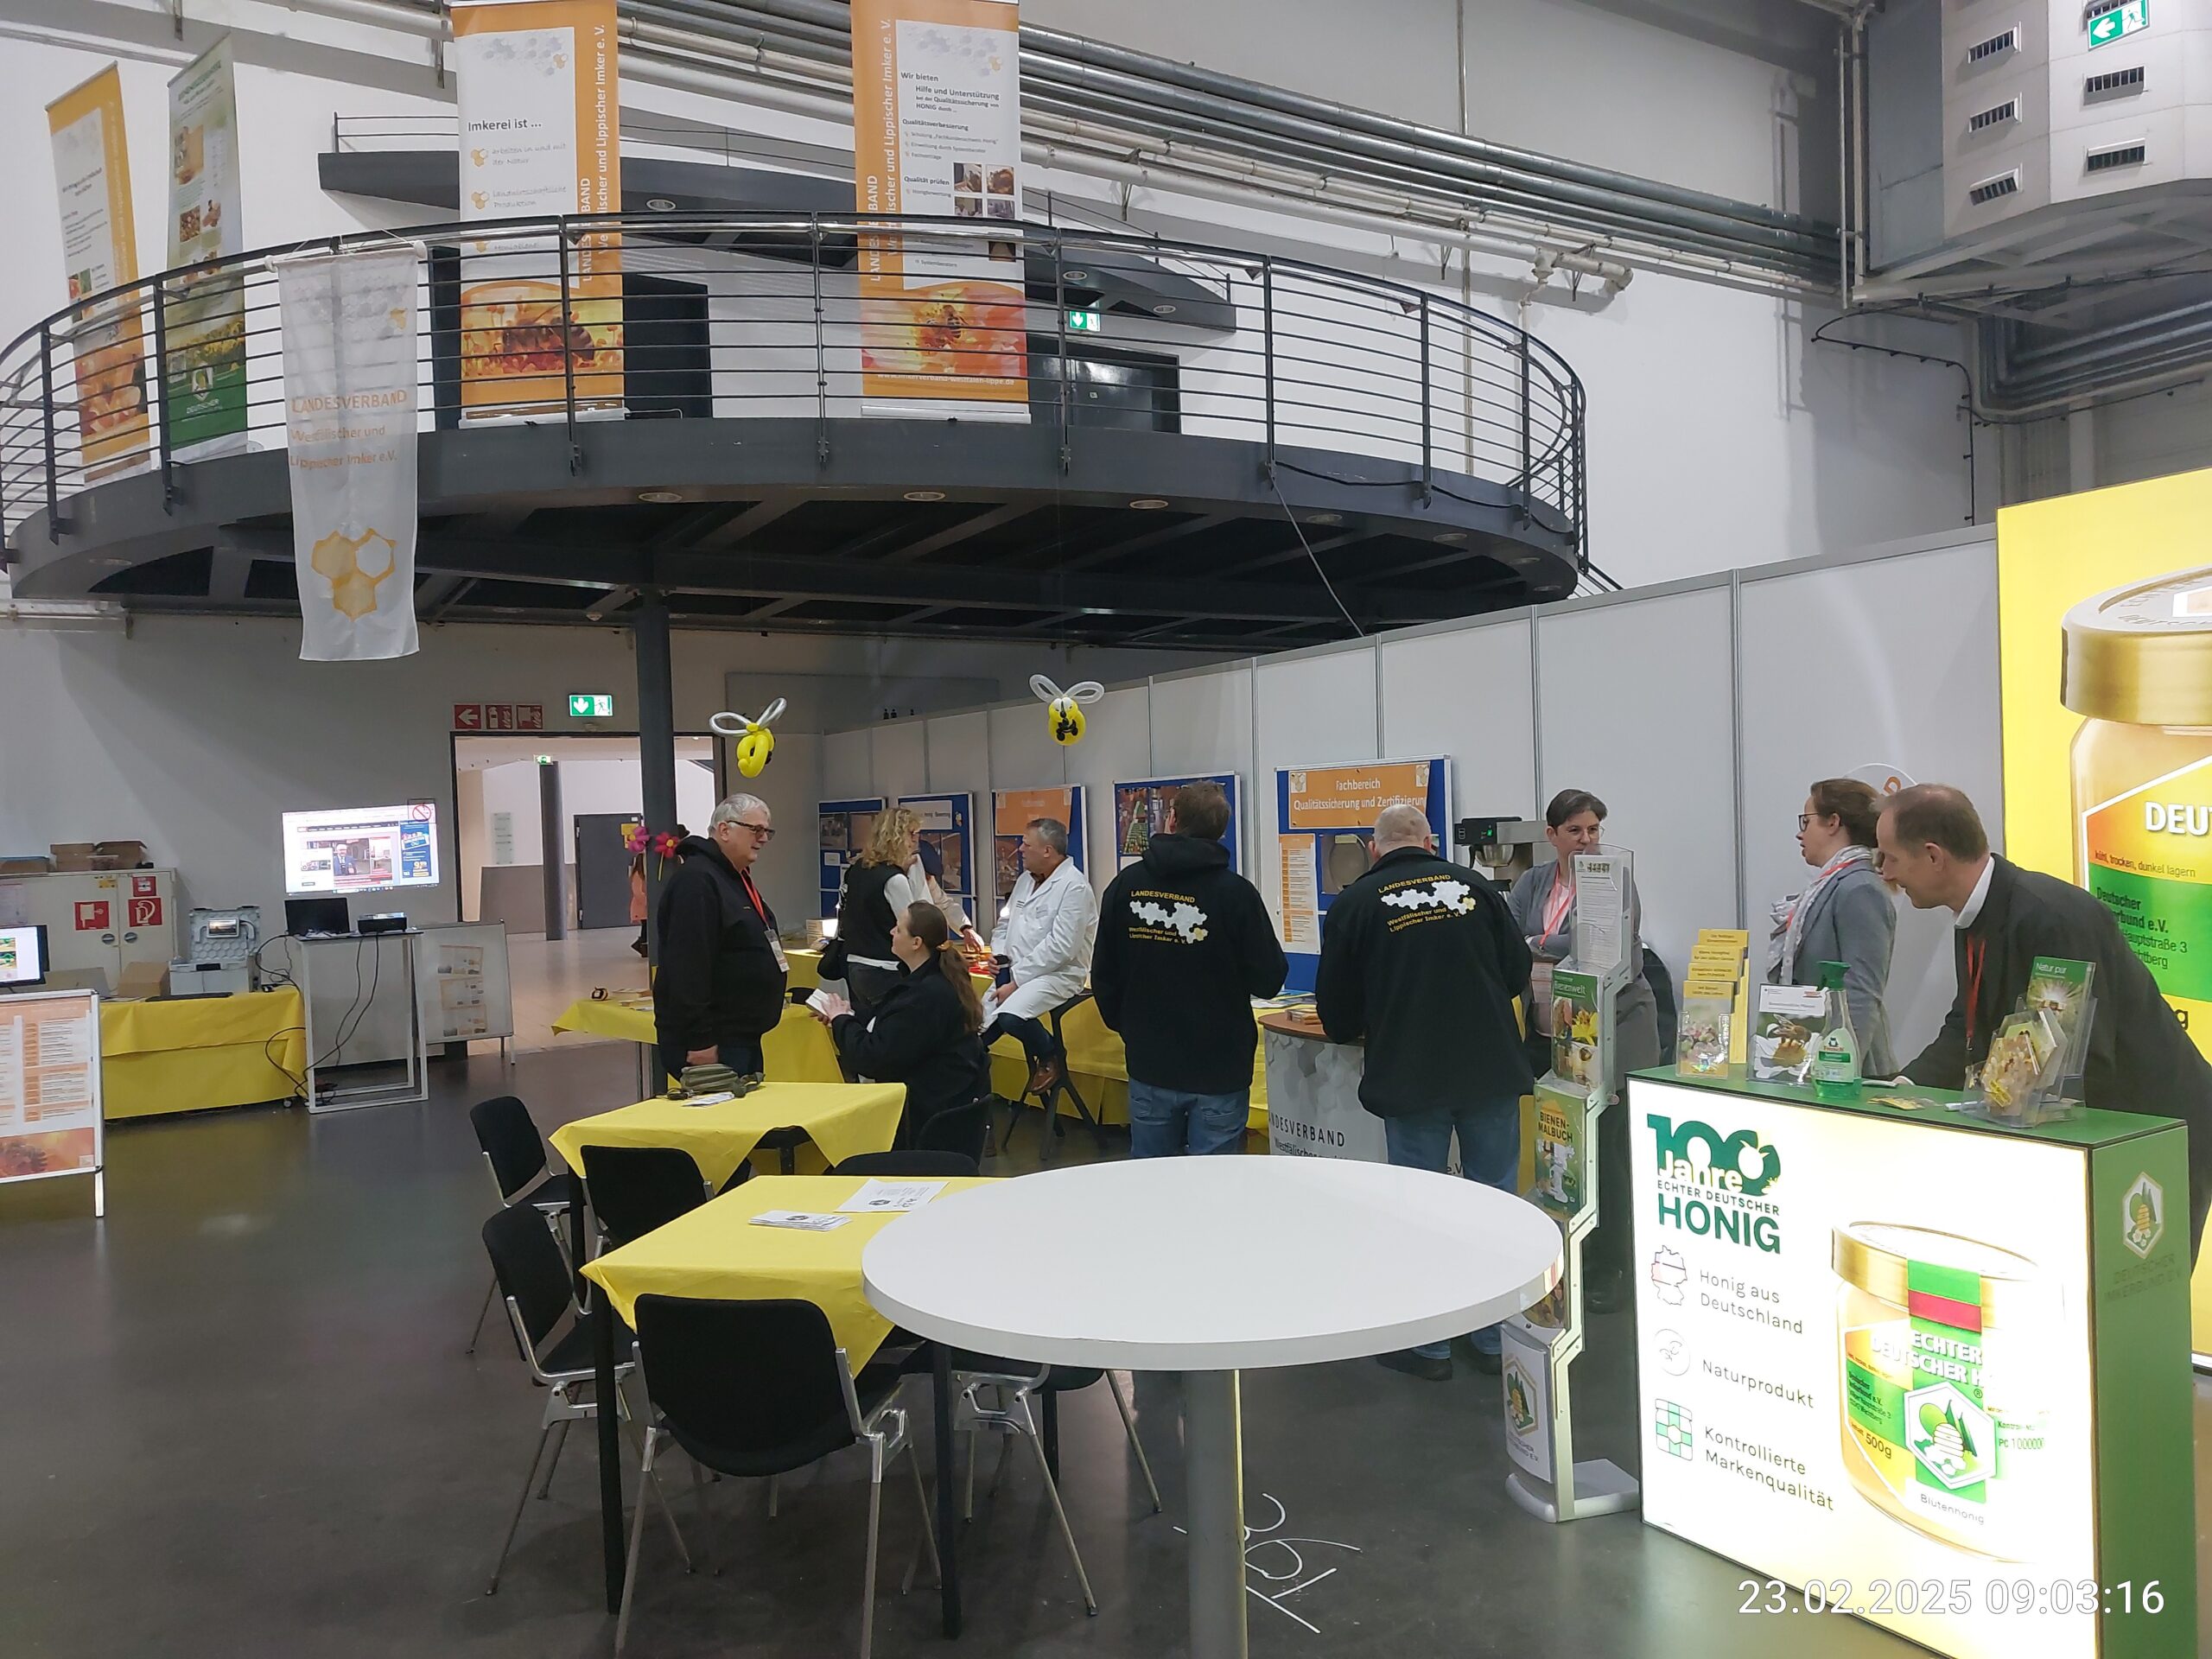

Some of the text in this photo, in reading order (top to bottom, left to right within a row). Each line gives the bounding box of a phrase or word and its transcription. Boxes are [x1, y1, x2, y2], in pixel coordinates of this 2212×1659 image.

[594, 24, 605, 35] V.
[880, 19, 891, 30] V.
[595, 37, 605, 48] e.
[881, 31, 891, 44] e.
[594, 52, 606, 85] Imker
[881, 47, 893, 82] Imker
[916, 73, 938, 82] bieten
[950, 89, 1000, 100] Unterstützung
[468, 119, 511, 131] Imkerei
[514, 118, 527, 129] ist
[595, 89, 609, 147] Lippischer
[883, 85, 896, 146] Lippischer
[596, 150, 608, 172] und
[885, 149, 896, 173] und
[904, 175, 950, 187] Qualität prüfen
[291, 390, 407, 413] LANDESVERBAND
[365, 425, 385, 436] und
[347, 453, 377, 464] Imker
[378, 450, 397, 462] e.V.
[1336, 778, 1381, 791] Fachbereich
[1294, 798, 1360, 810] Qualitätssicherung
[1362, 796, 1376, 807] und
[2110, 855, 2137, 870] trocken,
[2139, 861, 2164, 874] dunkel
[2167, 865, 2196, 878] lagern
[1378, 874, 1451, 893] LANDESVERBAND
[1131, 890, 1195, 903] LANDESVERBAND
[2096, 887, 2141, 911] Deutscher
[1387, 910, 1433, 926] Westfälischer
[1389, 918, 1423, 932] Lippischer
[2148, 918, 2169, 933] e.V.
[2180, 942, 2188, 953] 3
[2036, 962, 2068, 975] Natur pur
[1540, 1111, 1569, 1128] BIENEN-
[1538, 1122, 1573, 1142] MALBUCH
[1647, 1113, 1781, 1197] 100
[1659, 1150, 1743, 1193] Jahre
[1657, 1179, 1779, 1216] ECHTER DEUTSCHER
[1658, 1192, 1780, 1255] HONIG
[1700, 1269, 1780, 1304] Honig aus
[1700, 1293, 1802, 1334] Deutschland
[1911, 1331, 1982, 1365] ECHTER
[1703, 1359, 1814, 1408] Naturprodukt
[1706, 1426, 1806, 1475] Kontrollierte
[1866, 1433, 1891, 1459] 500g
[1707, 1449, 1834, 1510] Markenqualität
